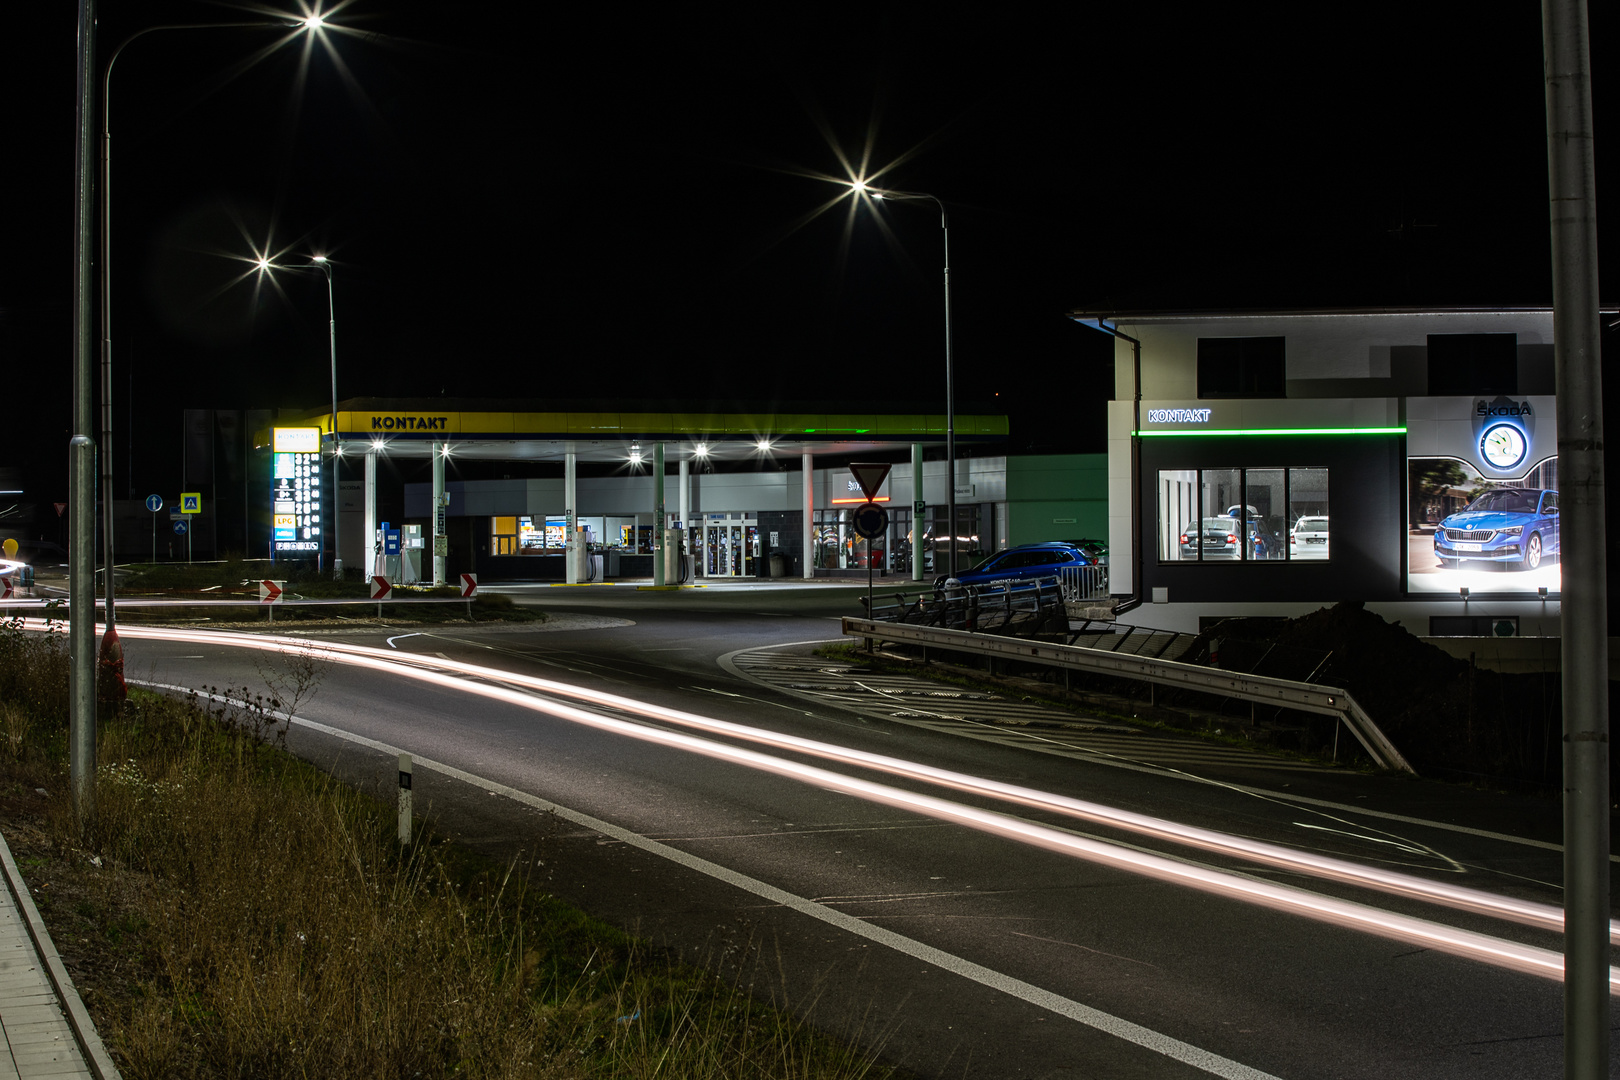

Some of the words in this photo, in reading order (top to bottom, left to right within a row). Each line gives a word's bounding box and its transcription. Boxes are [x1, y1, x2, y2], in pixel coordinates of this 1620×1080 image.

[1148, 408, 1212, 423] KONTAKT
[371, 416, 448, 430] KONTAKT
[277, 517, 293, 525] LPG
